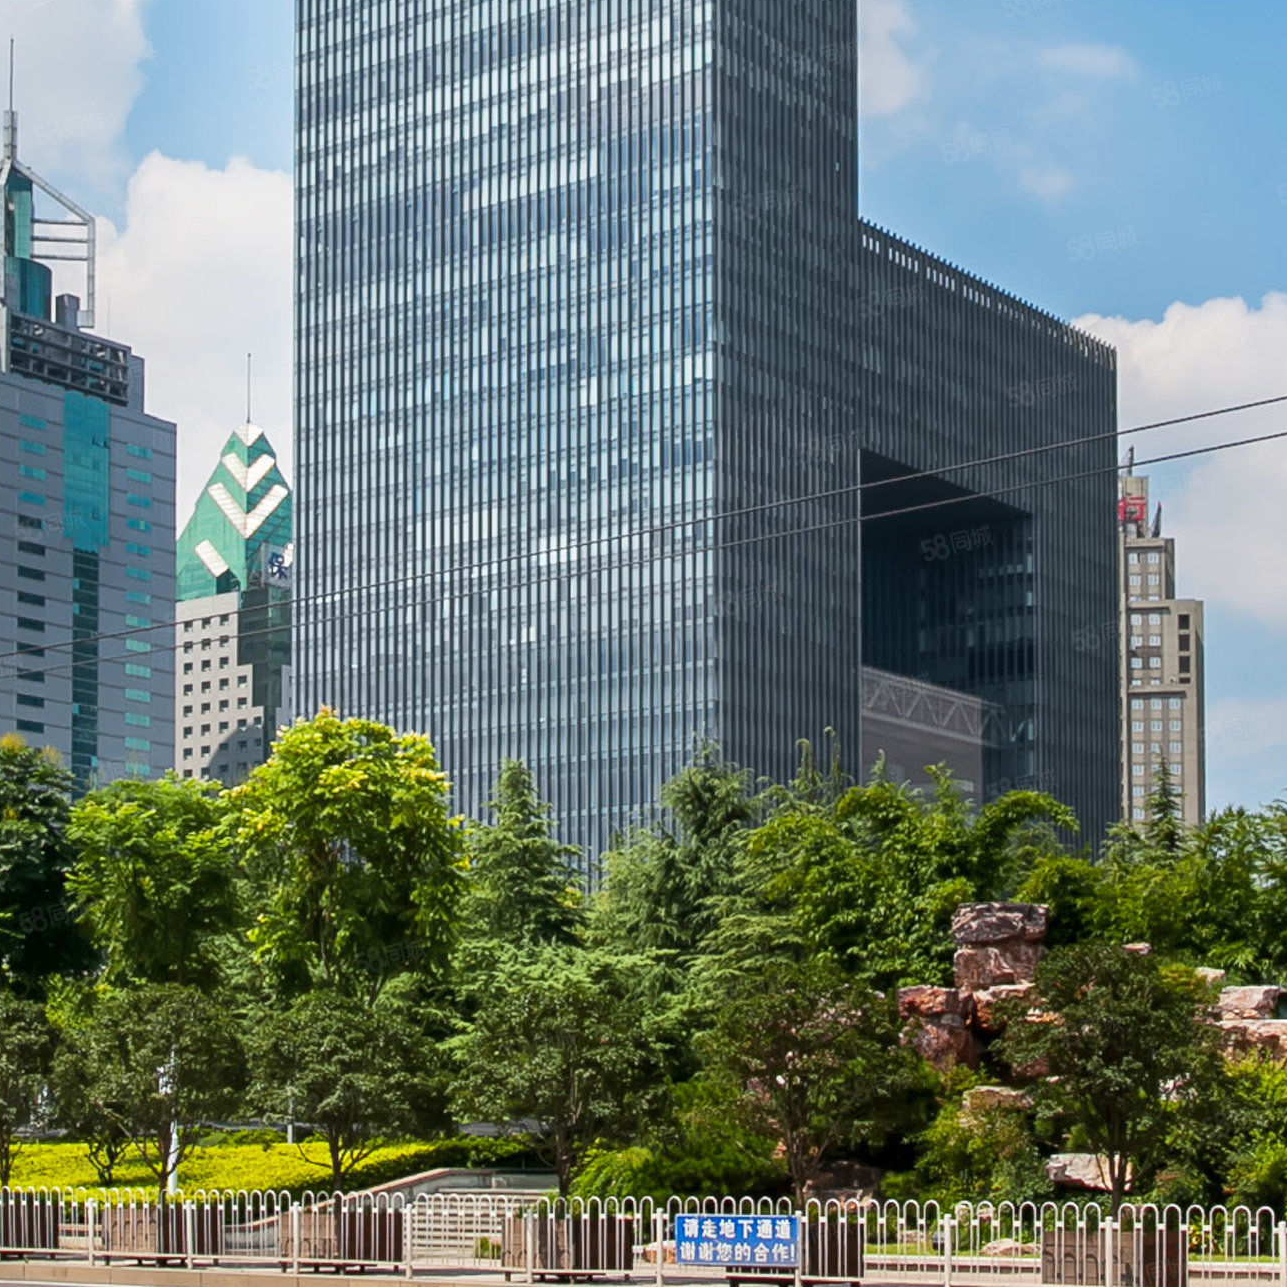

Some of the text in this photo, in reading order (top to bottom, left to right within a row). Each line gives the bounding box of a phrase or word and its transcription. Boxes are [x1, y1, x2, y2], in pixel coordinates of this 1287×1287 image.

[683, 1218, 791, 1239] 请走地下通道
[679, 1242, 795, 1262] 谢谢您的合作!
